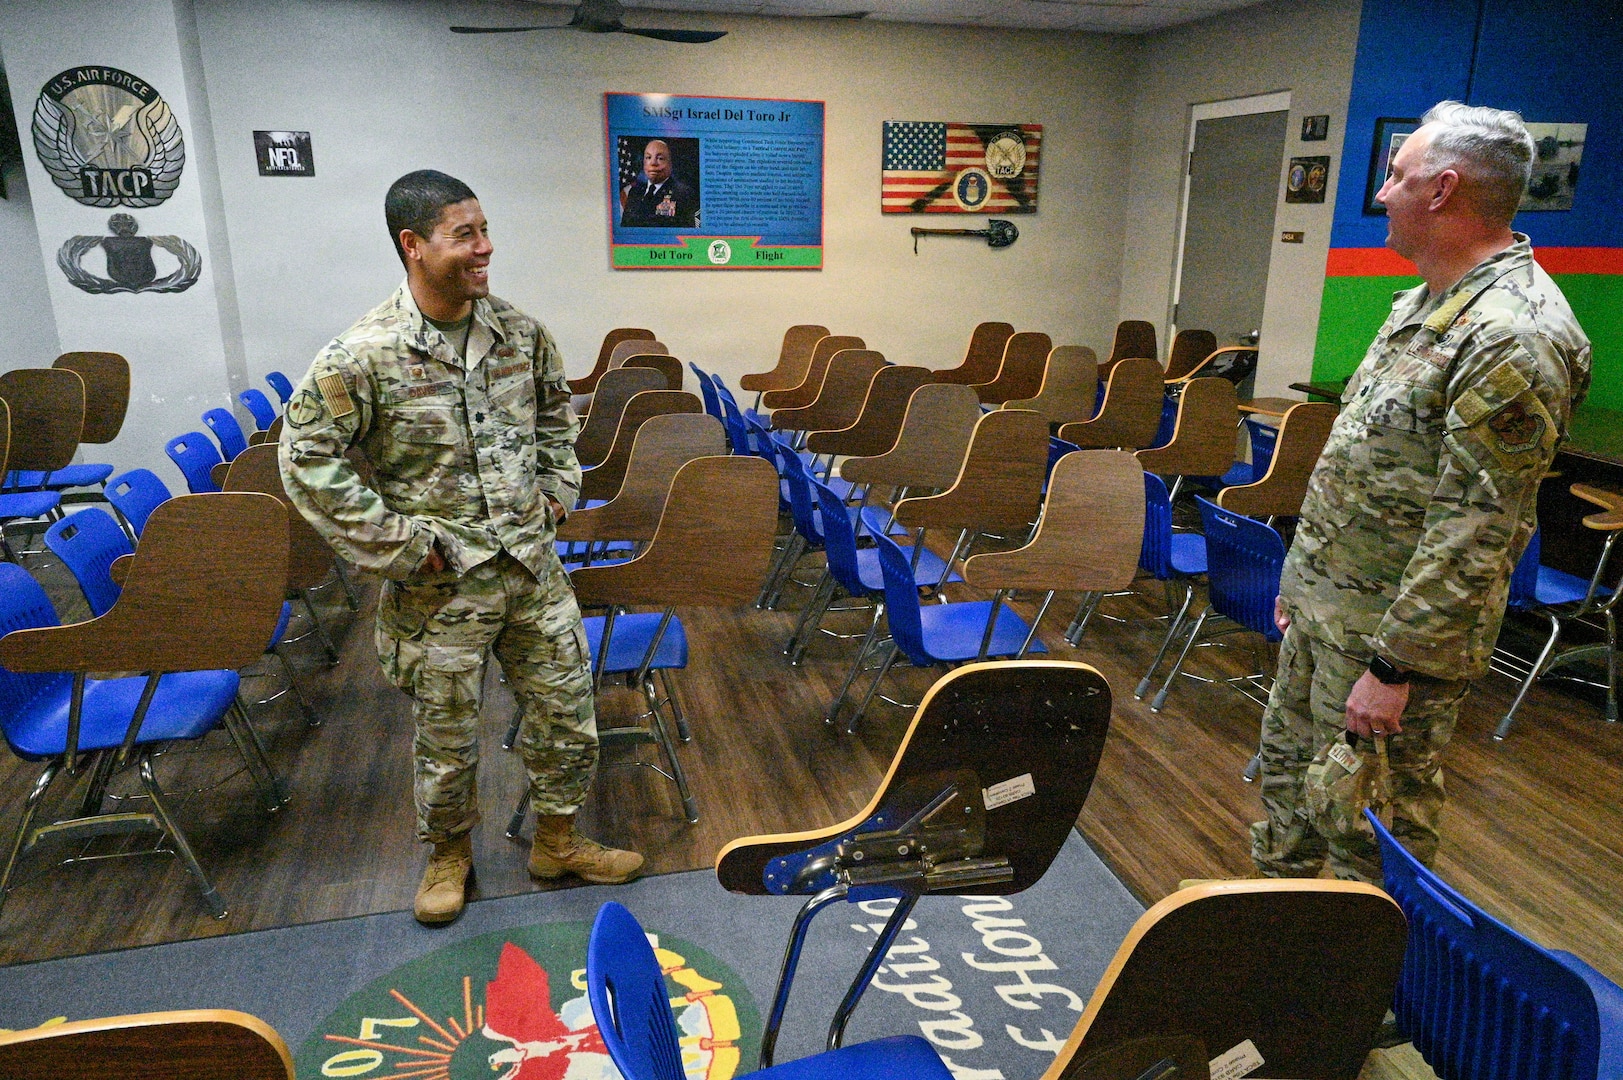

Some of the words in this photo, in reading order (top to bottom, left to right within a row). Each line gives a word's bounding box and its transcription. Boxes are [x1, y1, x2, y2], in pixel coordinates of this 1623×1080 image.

[51, 76, 76, 95] U.S.
[76, 69, 100, 82] AIR
[103, 70, 150, 97] FORCE
[643, 106, 683, 120] SMSgt
[688, 108, 720, 120] Israel
[724, 109, 743, 120] Del
[747, 110, 775, 121] Toro
[778, 111, 791, 122] Jr
[995, 166, 1015, 175] TACP
[84, 170, 149, 197] TACP
[650, 250, 666, 260] Del
[669, 251, 693, 260] Toro
[756, 251, 784, 262] Flight
[409, 386, 437, 398] DAVIS
[959, 895, 1085, 1011] Hon
[851, 897, 1005, 1080] raditio
